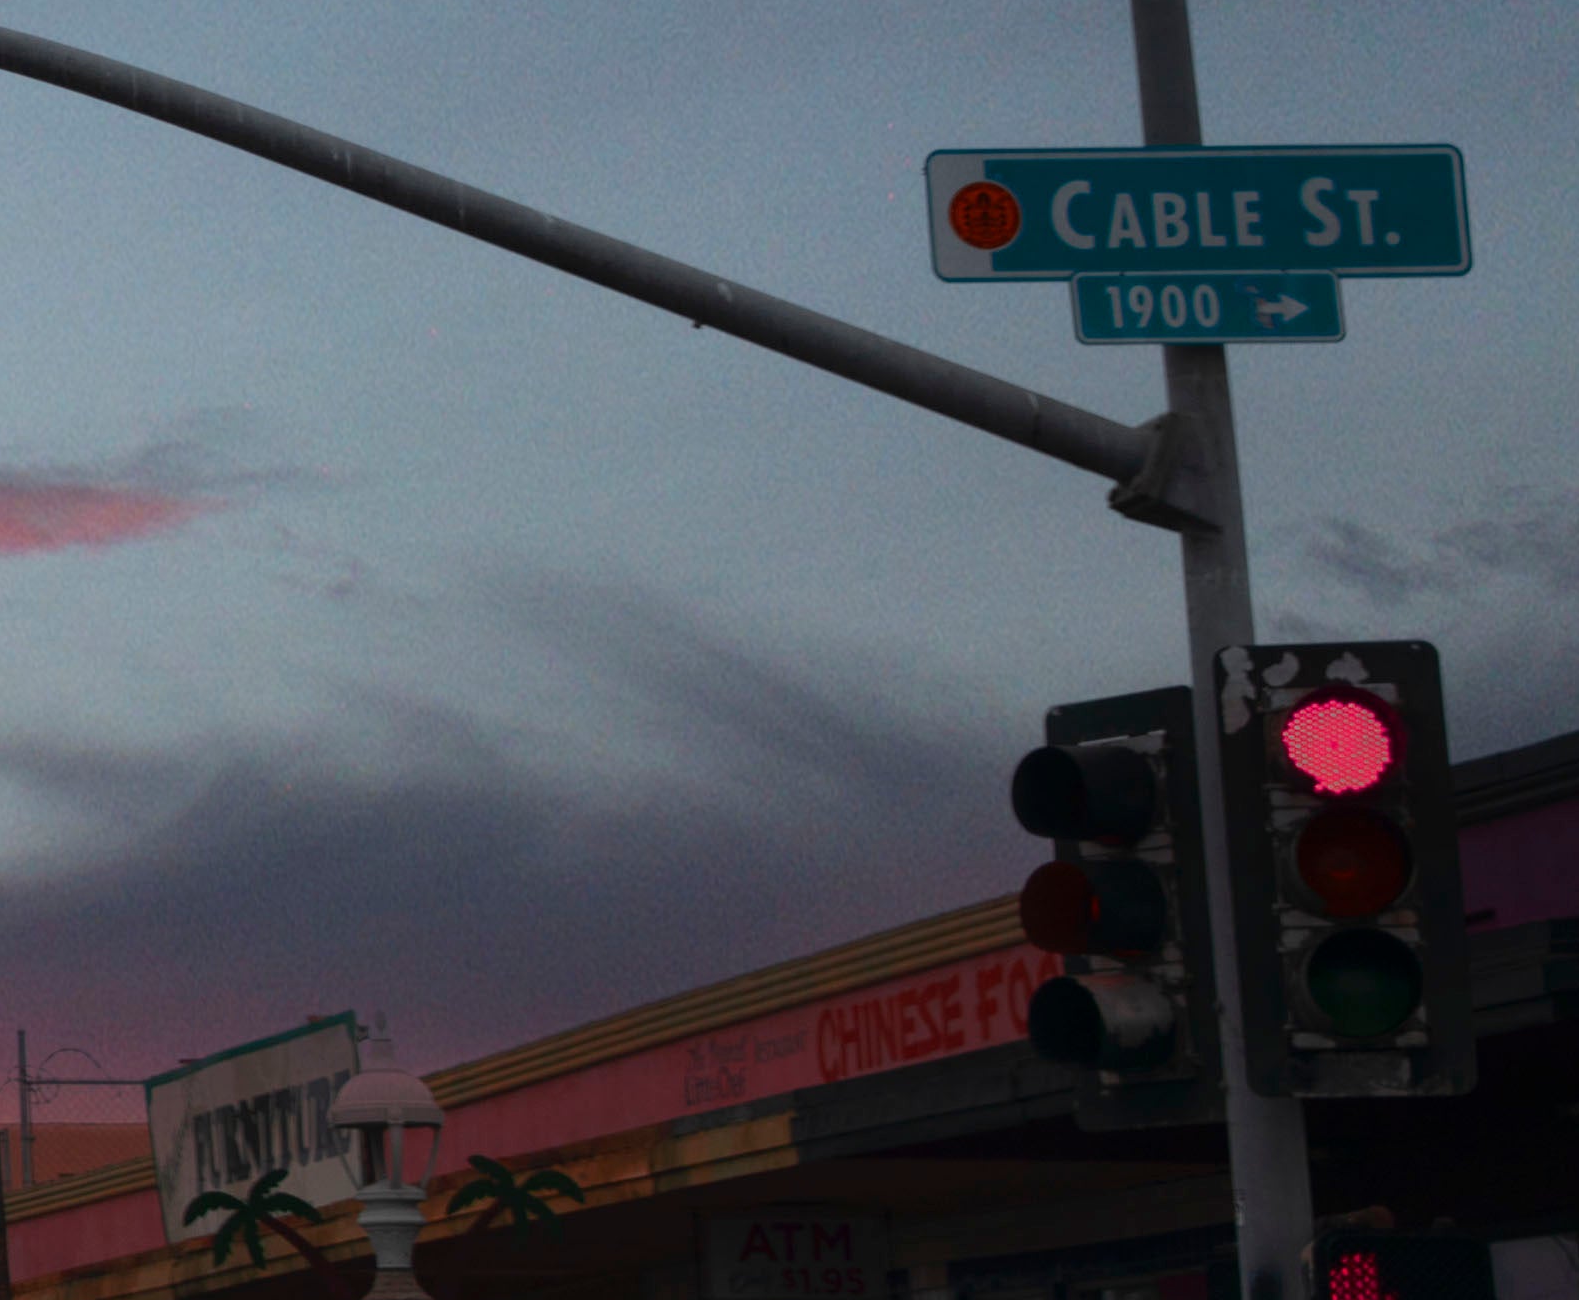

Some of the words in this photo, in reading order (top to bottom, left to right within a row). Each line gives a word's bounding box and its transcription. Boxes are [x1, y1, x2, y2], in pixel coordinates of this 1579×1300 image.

[1050, 178, 1265, 251] CABLE
[1105, 284, 1221, 330] 1900
[816, 974, 965, 1083] CHINESE
[738, 1221, 853, 1262] ATM
[780, 1266, 867, 1295] $1.95
